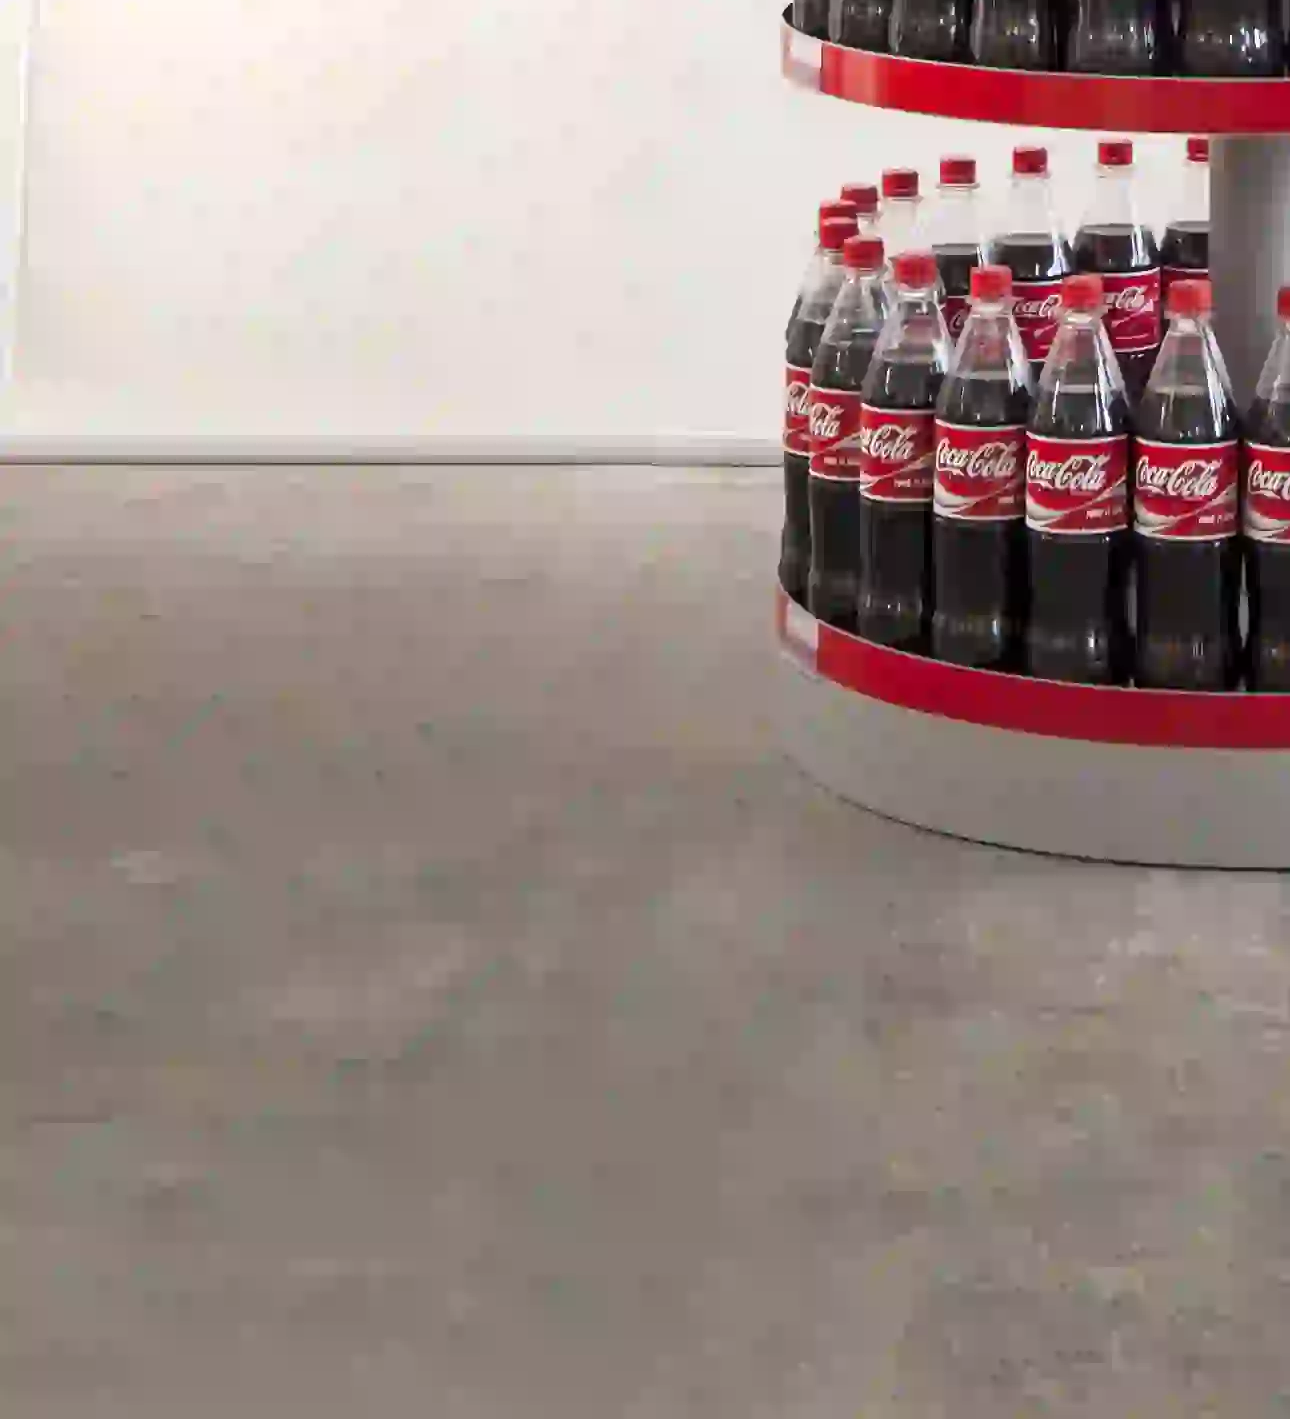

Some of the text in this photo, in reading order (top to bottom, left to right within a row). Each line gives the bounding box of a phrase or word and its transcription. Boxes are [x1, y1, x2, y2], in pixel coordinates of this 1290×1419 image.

[936, 437, 1020, 478] Coca-Cola
[1027, 450, 1110, 491] Coca-Cola
[1136, 455, 1222, 496] Coca-Cola
